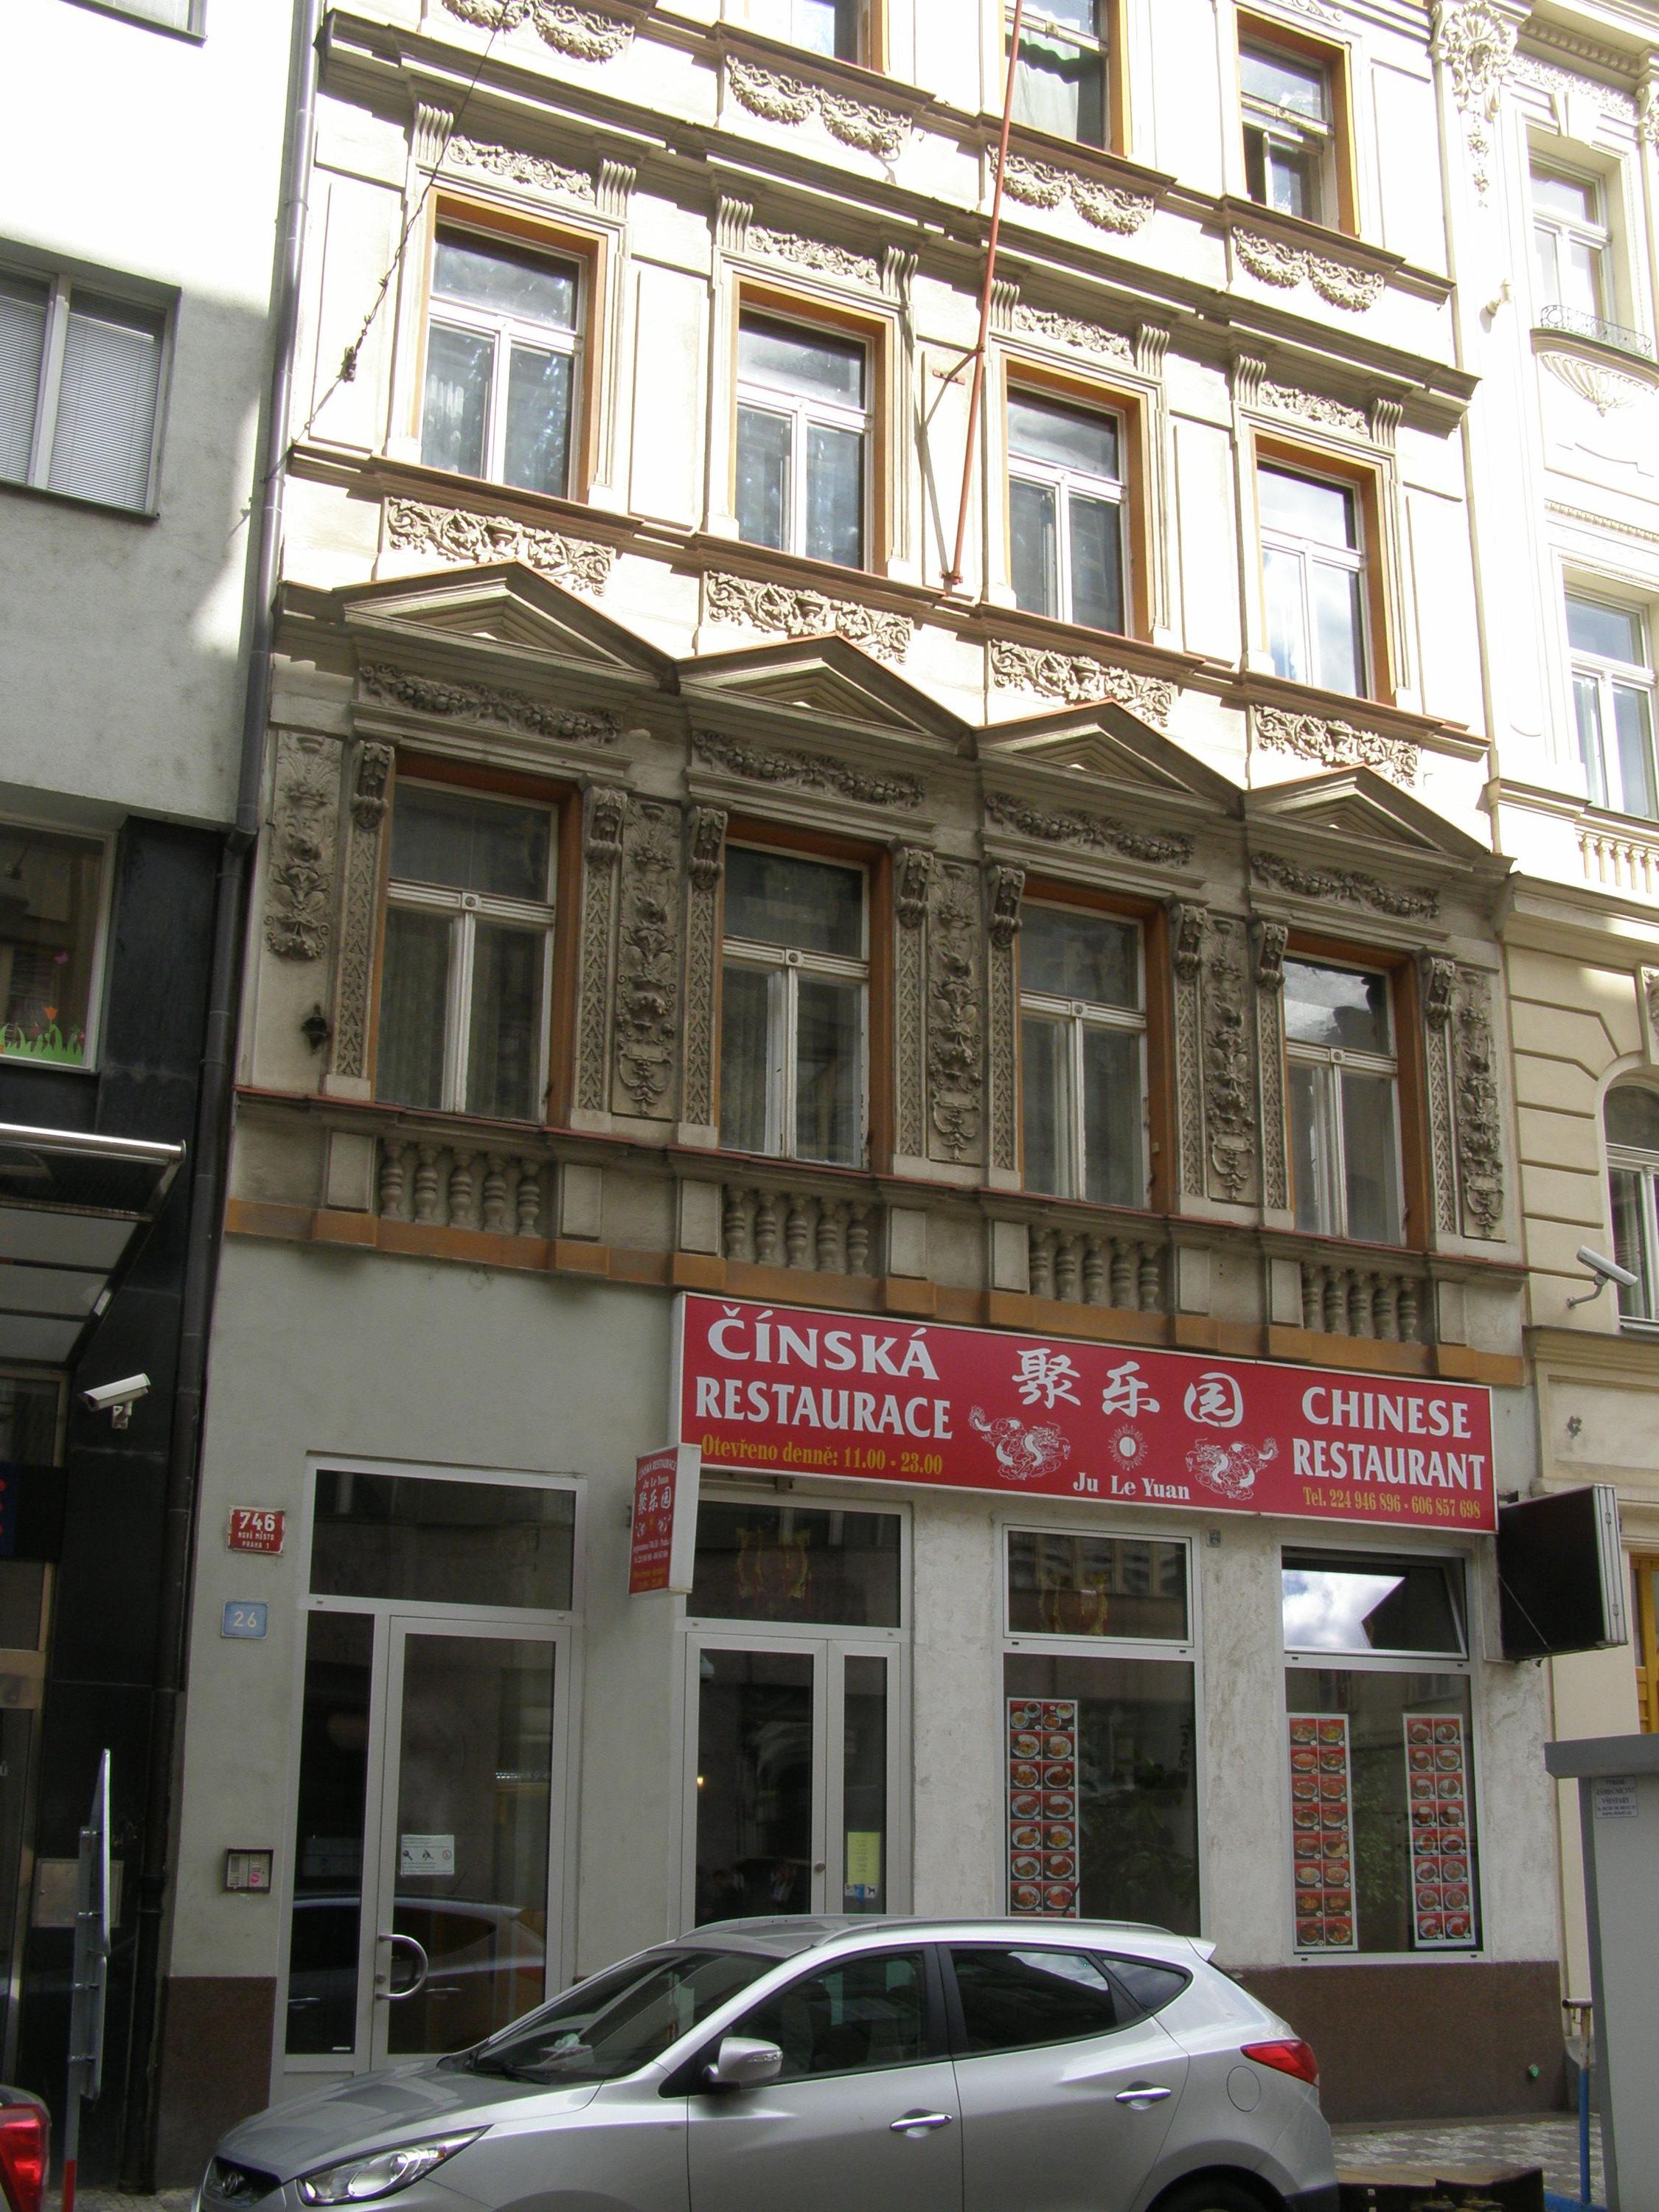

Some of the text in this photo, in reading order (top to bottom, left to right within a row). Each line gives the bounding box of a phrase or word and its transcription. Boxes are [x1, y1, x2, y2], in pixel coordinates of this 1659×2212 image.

[707, 1305, 940, 1380] ČÍNSKÁ
[695, 1377, 953, 1439] RESTAURACE
[1301, 1386, 1472, 1439] CHINESE
[701, 1434, 778, 1460] Otevřeno
[782, 1441, 838, 1467] denně:
[844, 1446, 885, 1470] 11.00
[900, 1452, 943, 1475] 23.00
[1292, 1438, 1485, 1490] RESTAURANT
[1073, 1472, 1191, 1500] Ju Le Yuan
[1303, 1486, 1326, 1506] Tel.
[1329, 1489, 1351, 1509] 224
[1354, 1492, 1376, 1511] 946
[1380, 1492, 1401, 1512] 896
[1411, 1495, 1433, 1515] 606
[1436, 1498, 1455, 1517] 857
[1460, 1499, 1481, 1519] 698
[240, 1512, 276, 1531] 746
[255, 1531, 274, 1541] MĚSTO
[242, 1540, 262, 1548] PRAHA
[233, 1610, 257, 1628] 26
